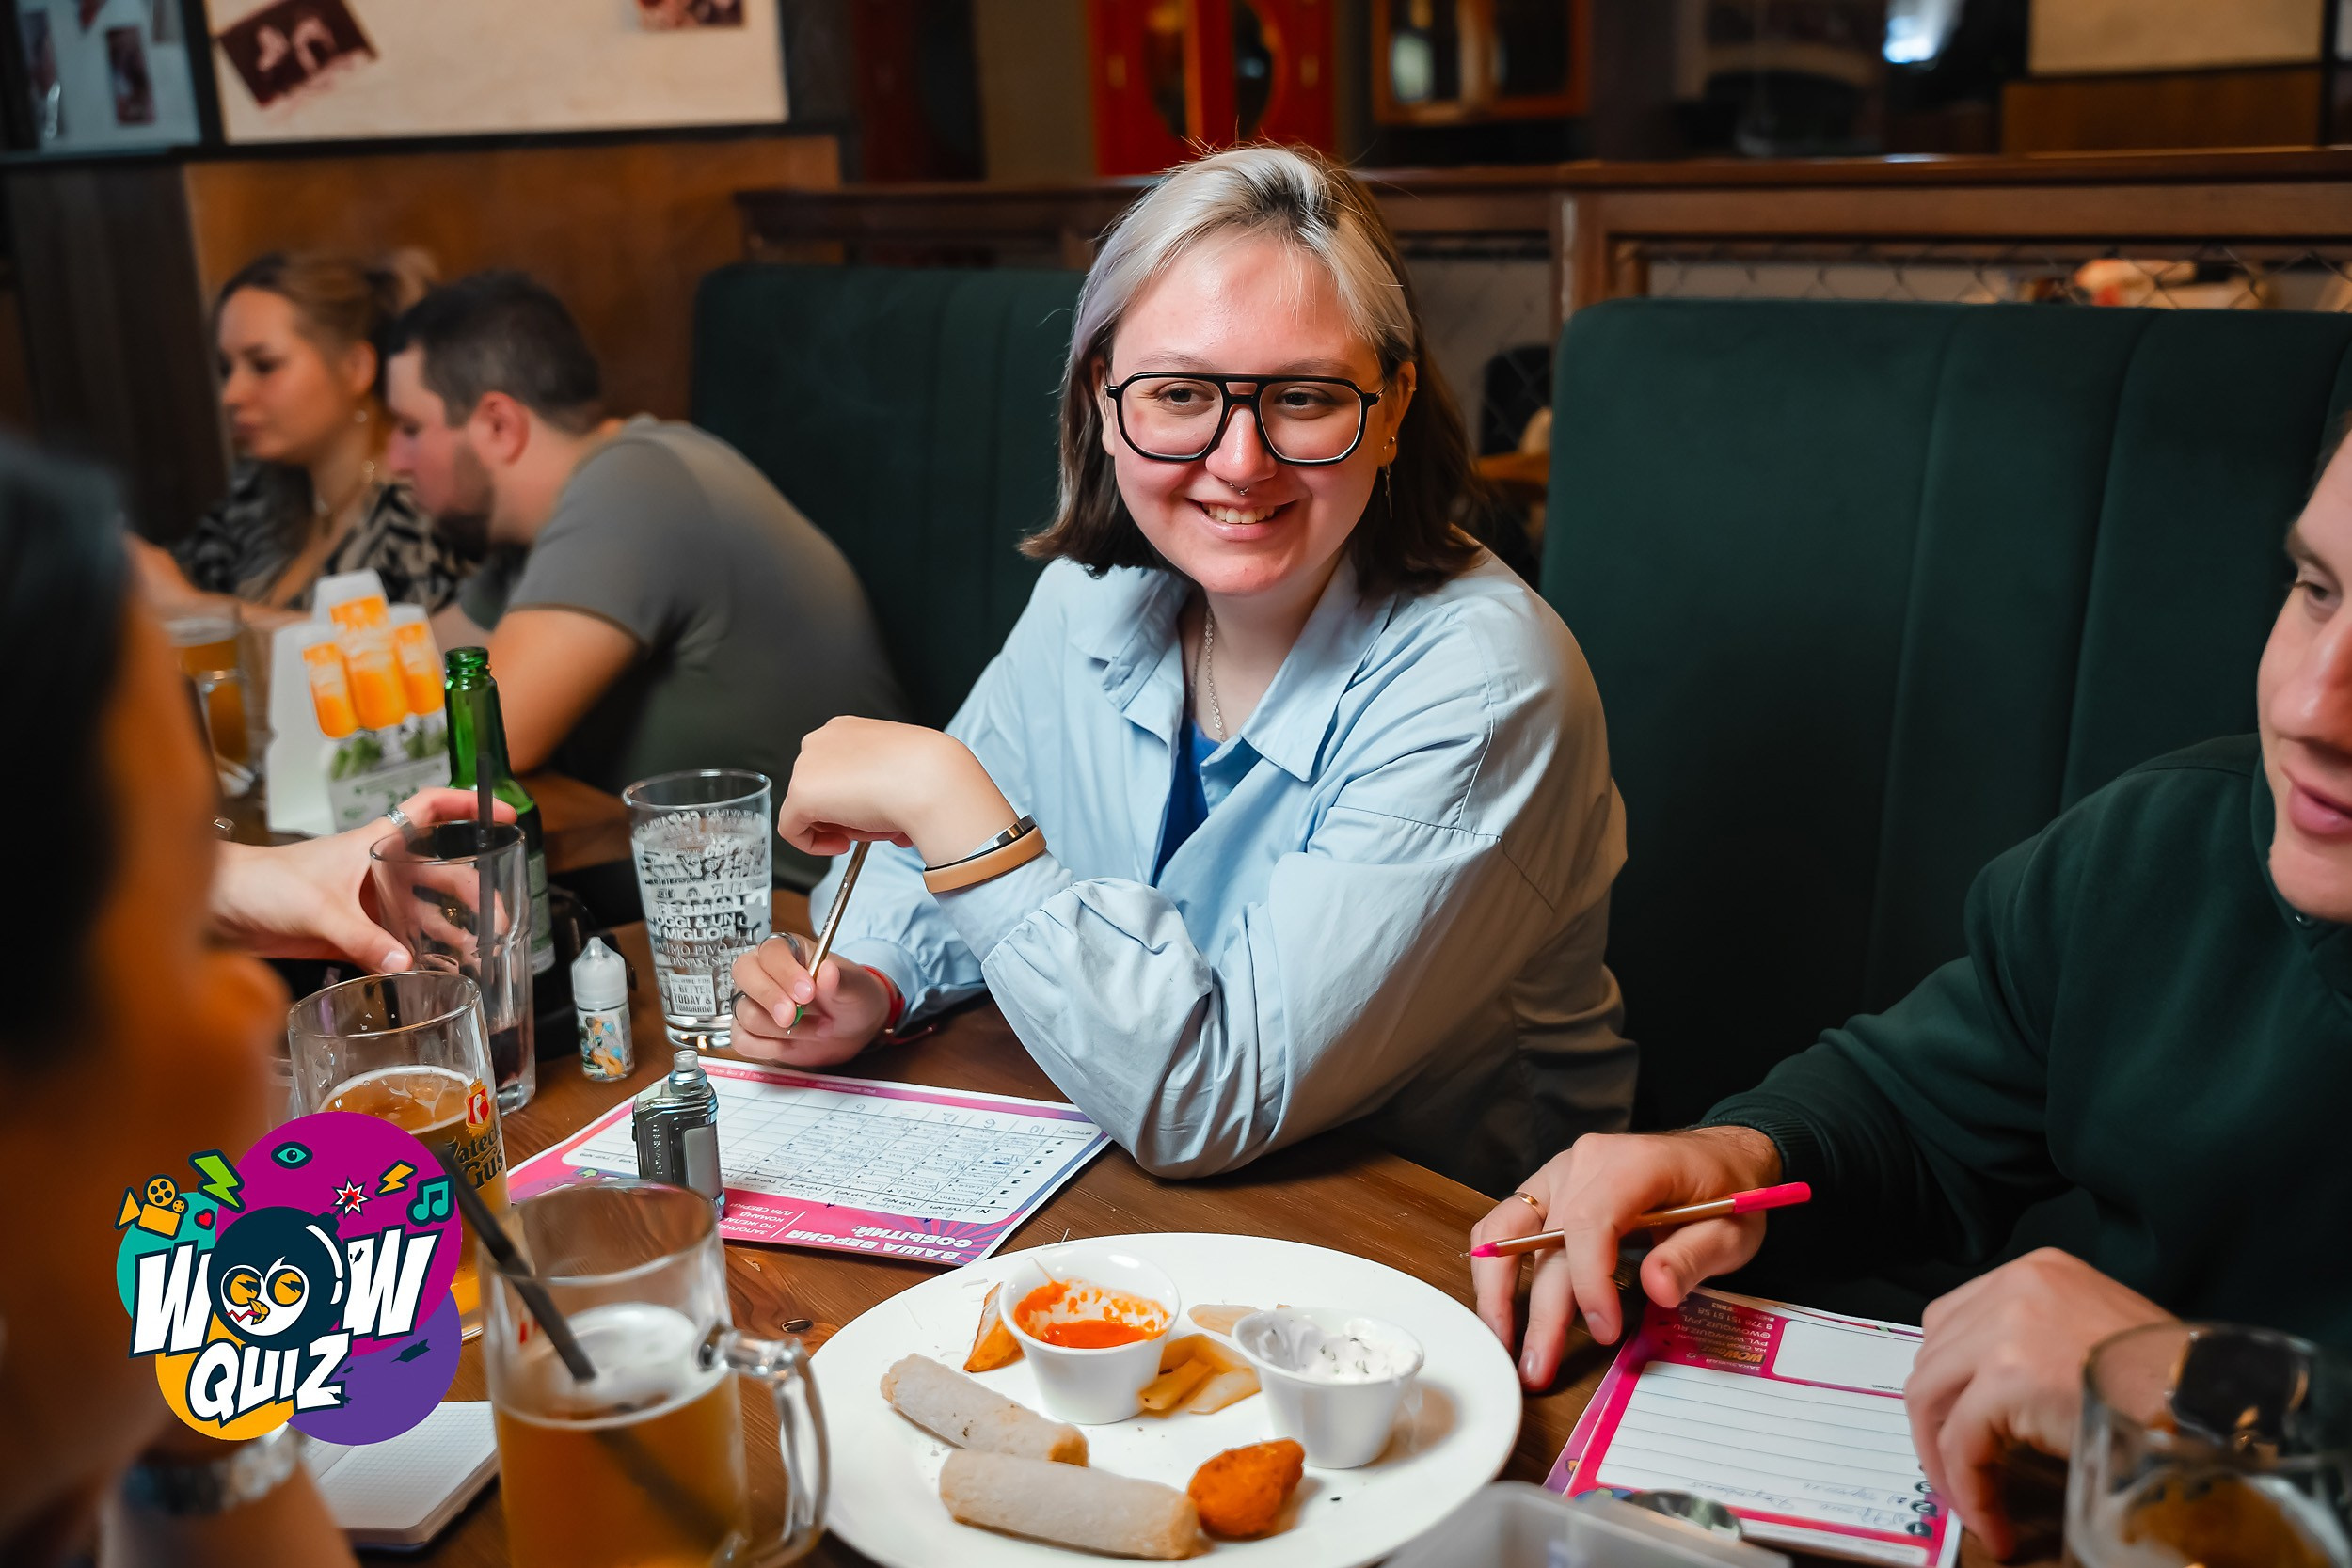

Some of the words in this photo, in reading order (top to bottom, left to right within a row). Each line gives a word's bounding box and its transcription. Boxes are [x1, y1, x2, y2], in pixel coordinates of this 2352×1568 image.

[674, 992, 701, 1005] TODAY
[706, 996, 713, 1005] &
[462, 1147, 504, 1191] Gus
[729, 1202, 769, 1212] СВЕРКИ
[739, 1211, 784, 1221] КОМАНД
[784, 1229, 880, 1249] ВЕРСИЯ
[850, 1225, 973, 1247] СОБЫТИЙ:
[882, 1242, 960, 1259] ВАША
[1674, 1323, 1768, 1346] PVL.WOWQUIZ.RU
[1683, 1314, 1770, 1338] @WOWQUIZ_PVL
